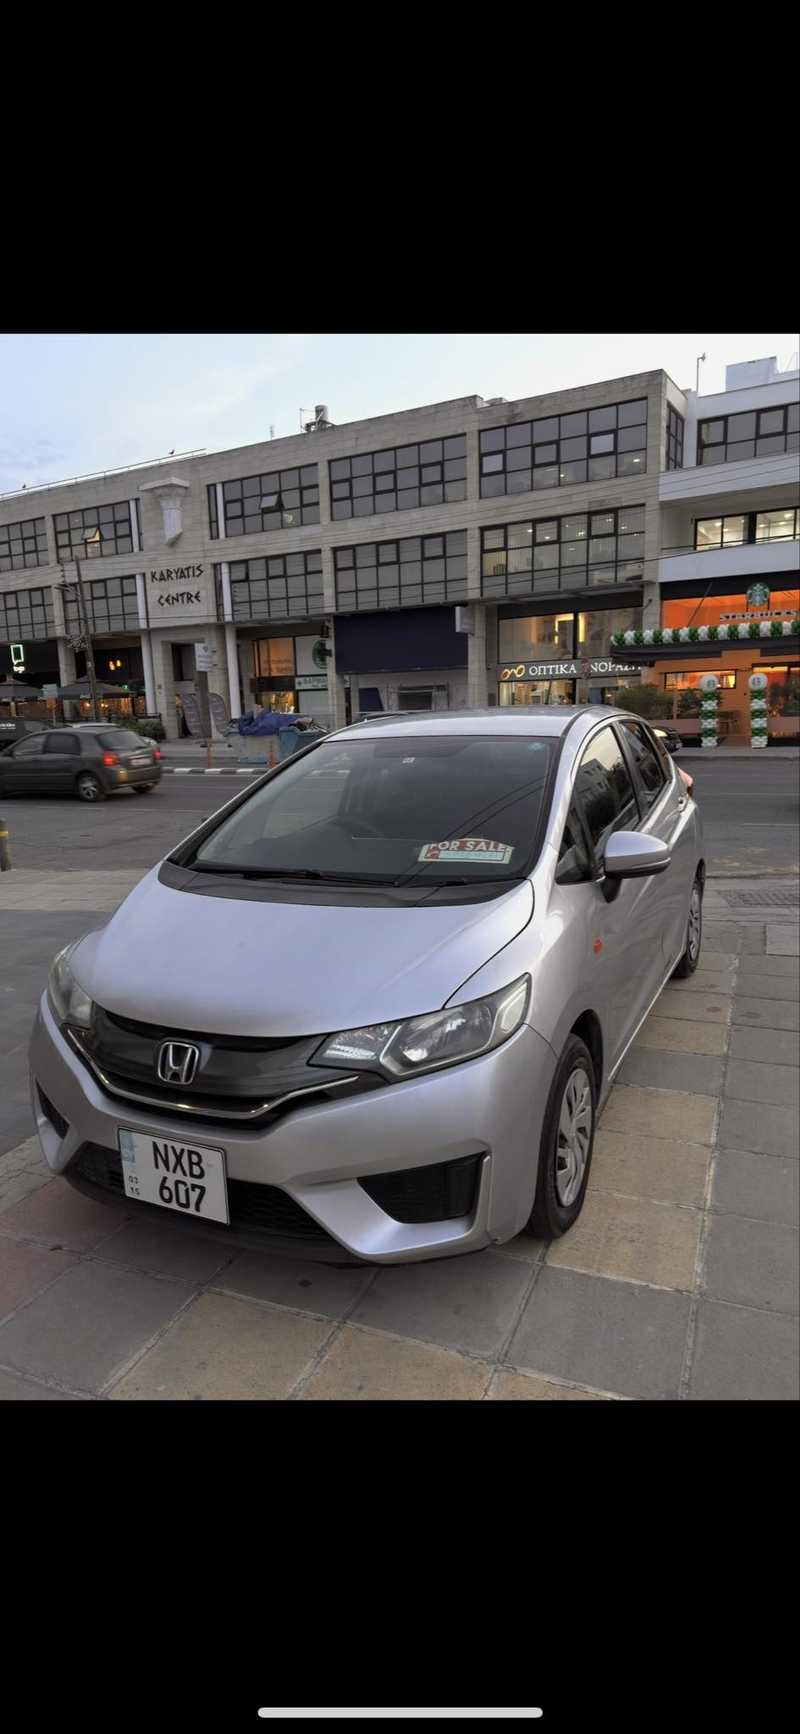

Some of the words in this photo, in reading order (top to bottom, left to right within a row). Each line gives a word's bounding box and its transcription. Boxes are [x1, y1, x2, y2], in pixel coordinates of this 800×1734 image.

[150, 564, 204, 582] KARYATIS
[157, 591, 201, 606] CENTRE
[529, 663, 577, 676] ΟΠΤΙΚΑ
[429, 840, 461, 851] FOR
[466, 840, 506, 852] SALE
[152, 1141, 205, 1180] NXB
[159, 1176, 206, 1212] 607
